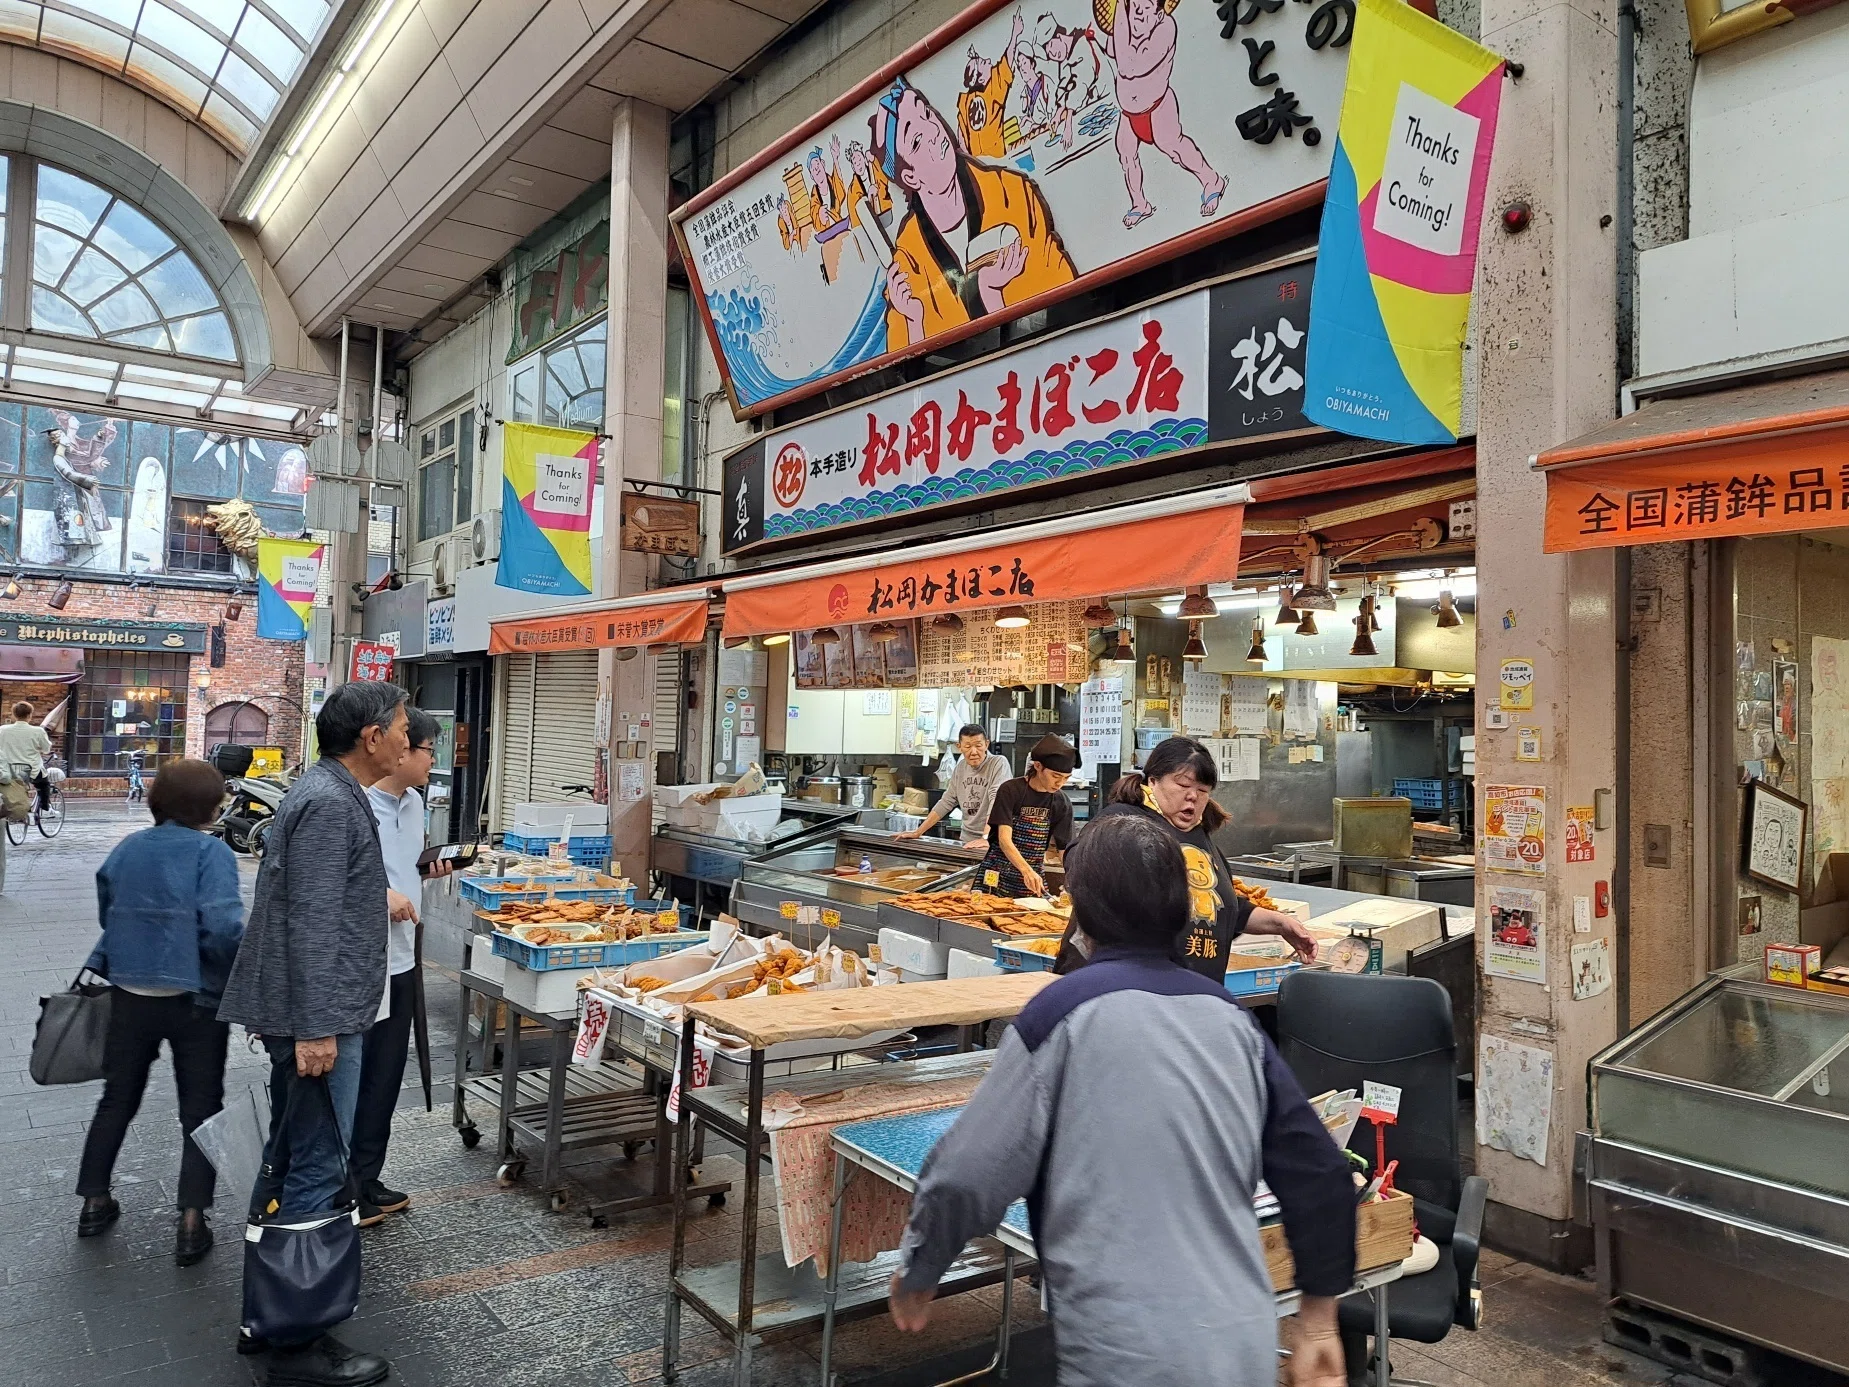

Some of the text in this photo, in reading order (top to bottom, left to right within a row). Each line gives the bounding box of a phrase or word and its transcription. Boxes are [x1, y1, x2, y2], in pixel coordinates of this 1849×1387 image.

[1405, 115, 1460, 165] Thanks
[1418, 166, 1434, 188] for
[1388, 181, 1453, 232] Coming!
[1228, 317, 1306, 401] 松
[858, 319, 1185, 488] 松岡かまぼこ店
[1335, 385, 1384, 404] いつもありがとう。
[558, 397, 593, 429] Medium
[1242, 406, 1284, 426] しょう
[1325, 396, 1391, 421] OBIYAMACHI
[545, 464, 582, 480] Thanks
[810, 447, 857, 479] 本手造り
[558, 481, 570, 491] for
[541, 490, 582, 507] Coming!
[288, 562, 314, 572] Thanks
[286, 578, 316, 588] Coming!
[521, 577, 561, 588] OBIYAMACHI
[866, 557, 1035, 614] 松岡かまぼこ店
[17, 624, 147, 645] Mephistopheles
[1100, 680, 1104, 691] 6
[1501, 673, 1533, 681] ジモッペイ
[1184, 935, 1218, 959] 美豚
